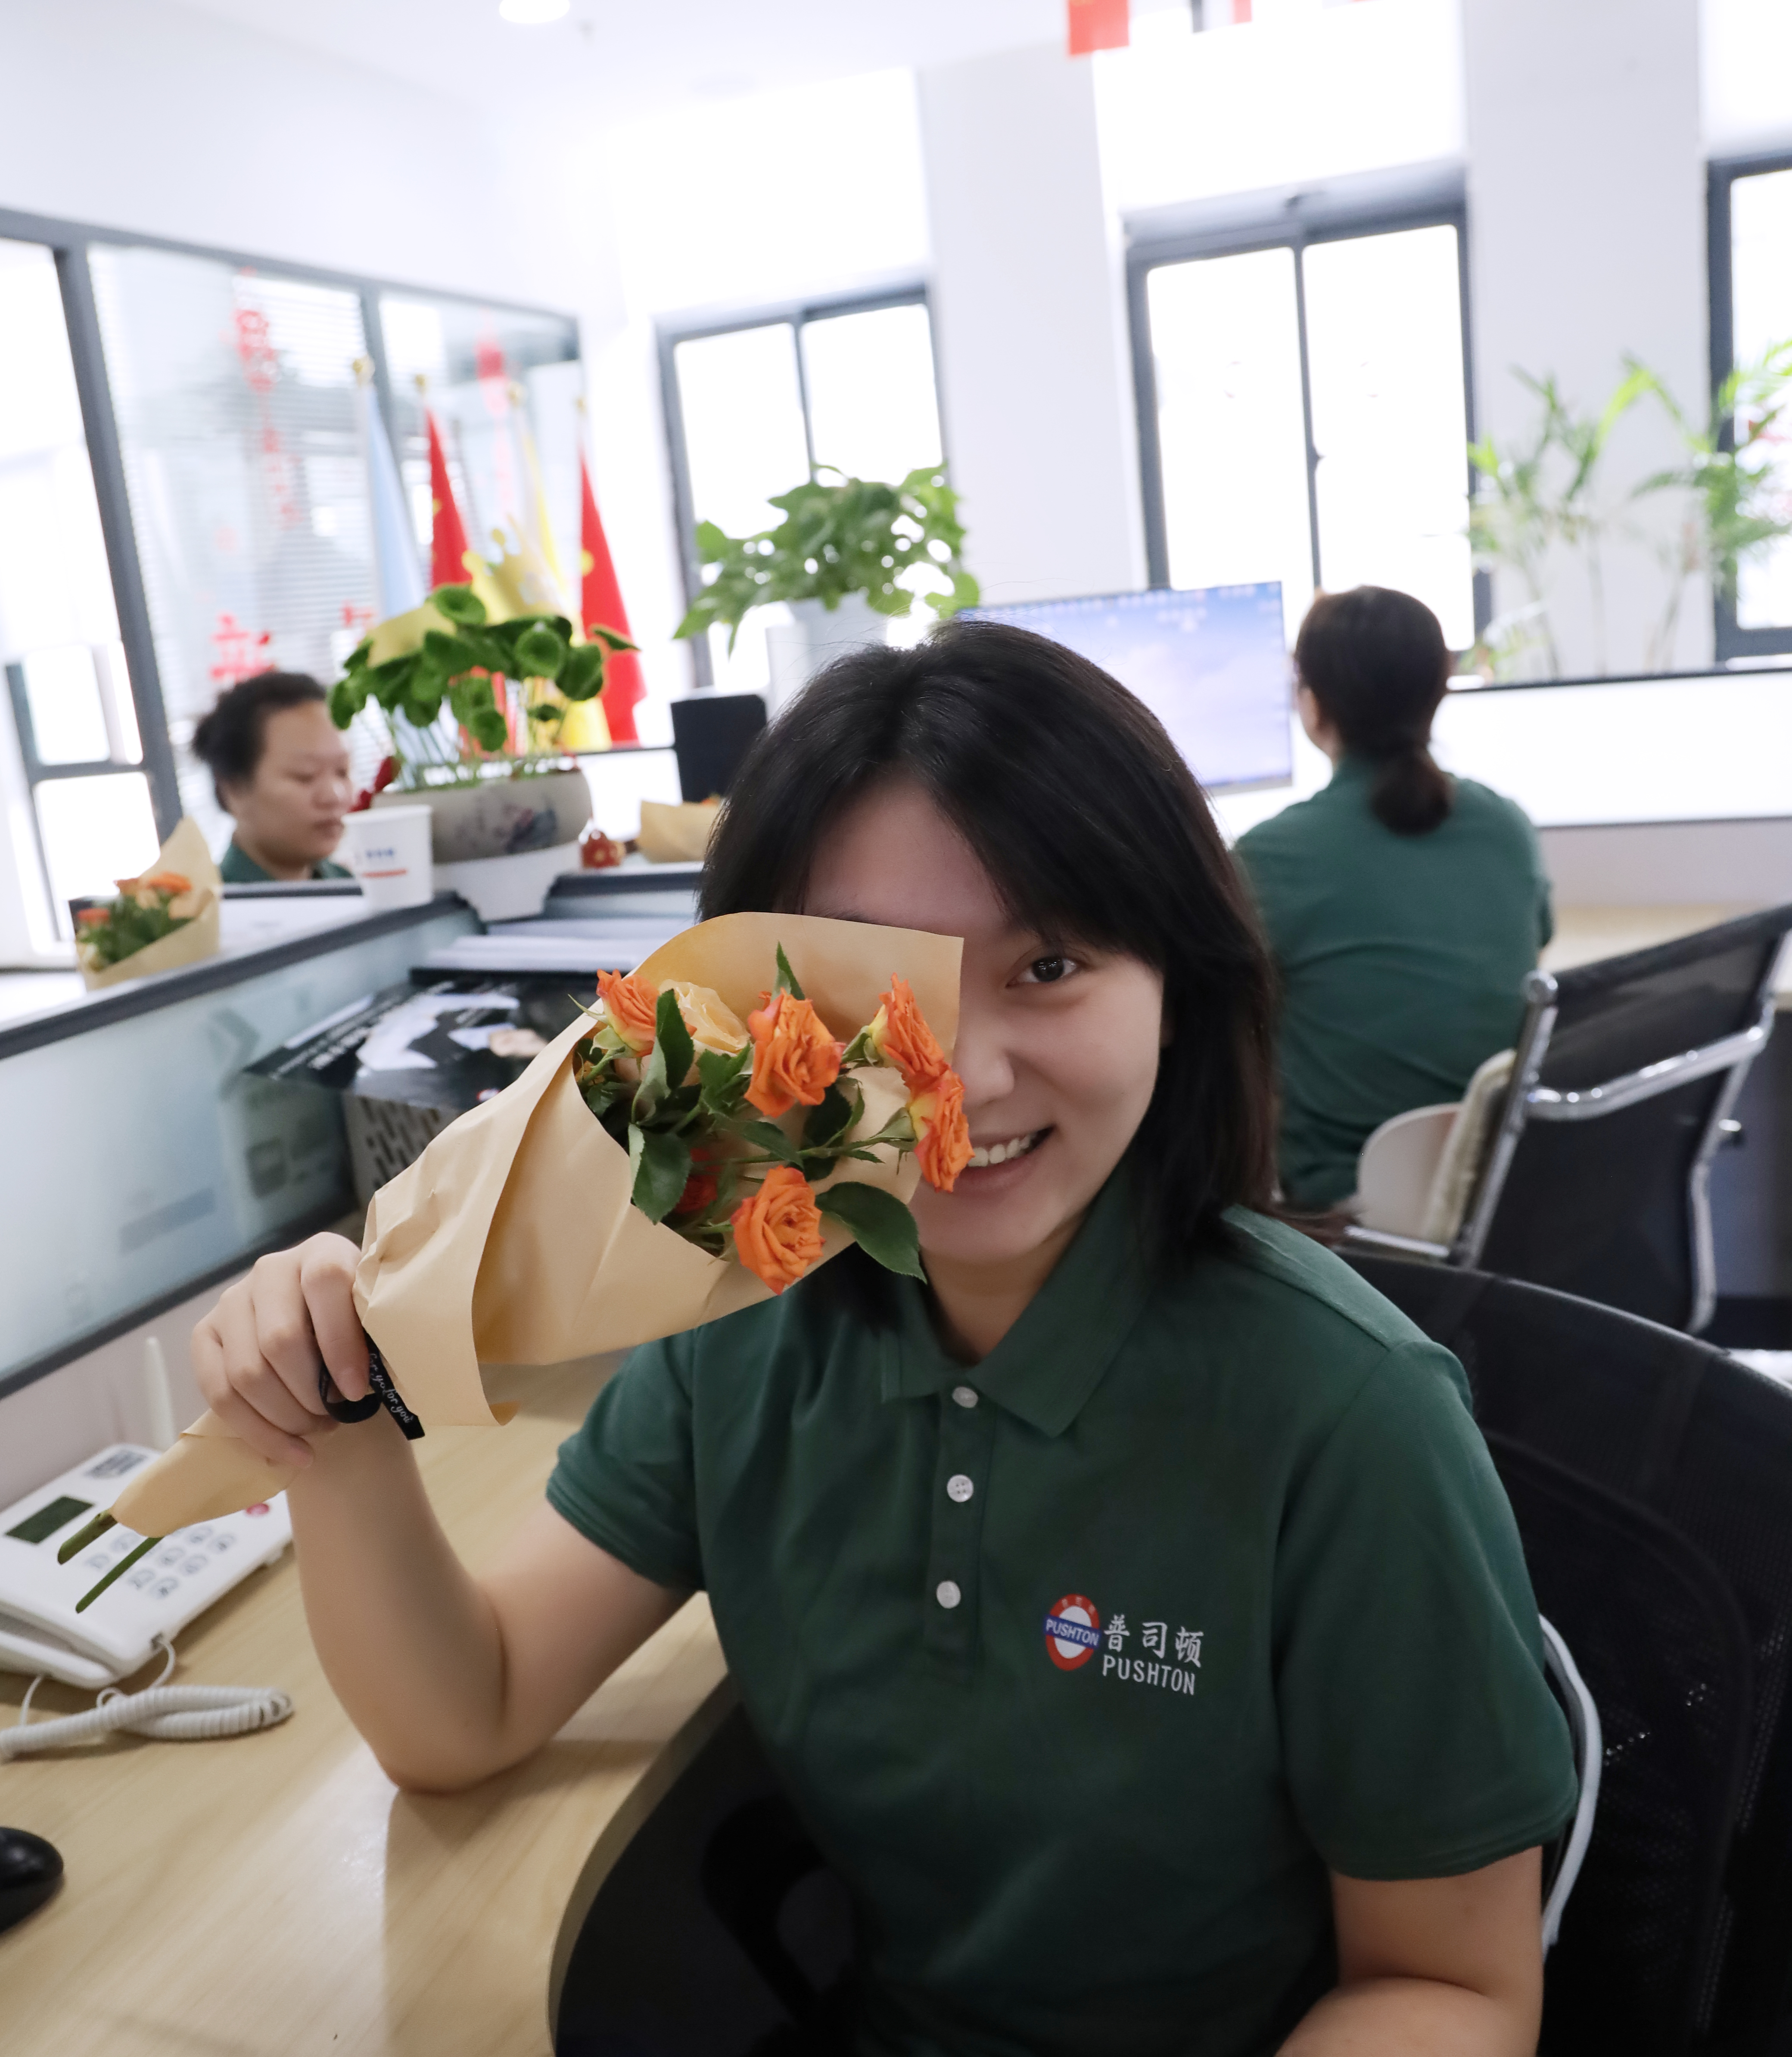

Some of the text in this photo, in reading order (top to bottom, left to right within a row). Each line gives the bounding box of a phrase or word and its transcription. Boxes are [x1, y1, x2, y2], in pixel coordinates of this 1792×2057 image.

[383, 1389, 398, 1404] for
[391, 1406, 414, 1423] you
[1046, 1619, 1099, 1646] PUSHTON
[1104, 1613, 1204, 1668] 普司顿
[1102, 1654, 1195, 1696] PUSHTON
